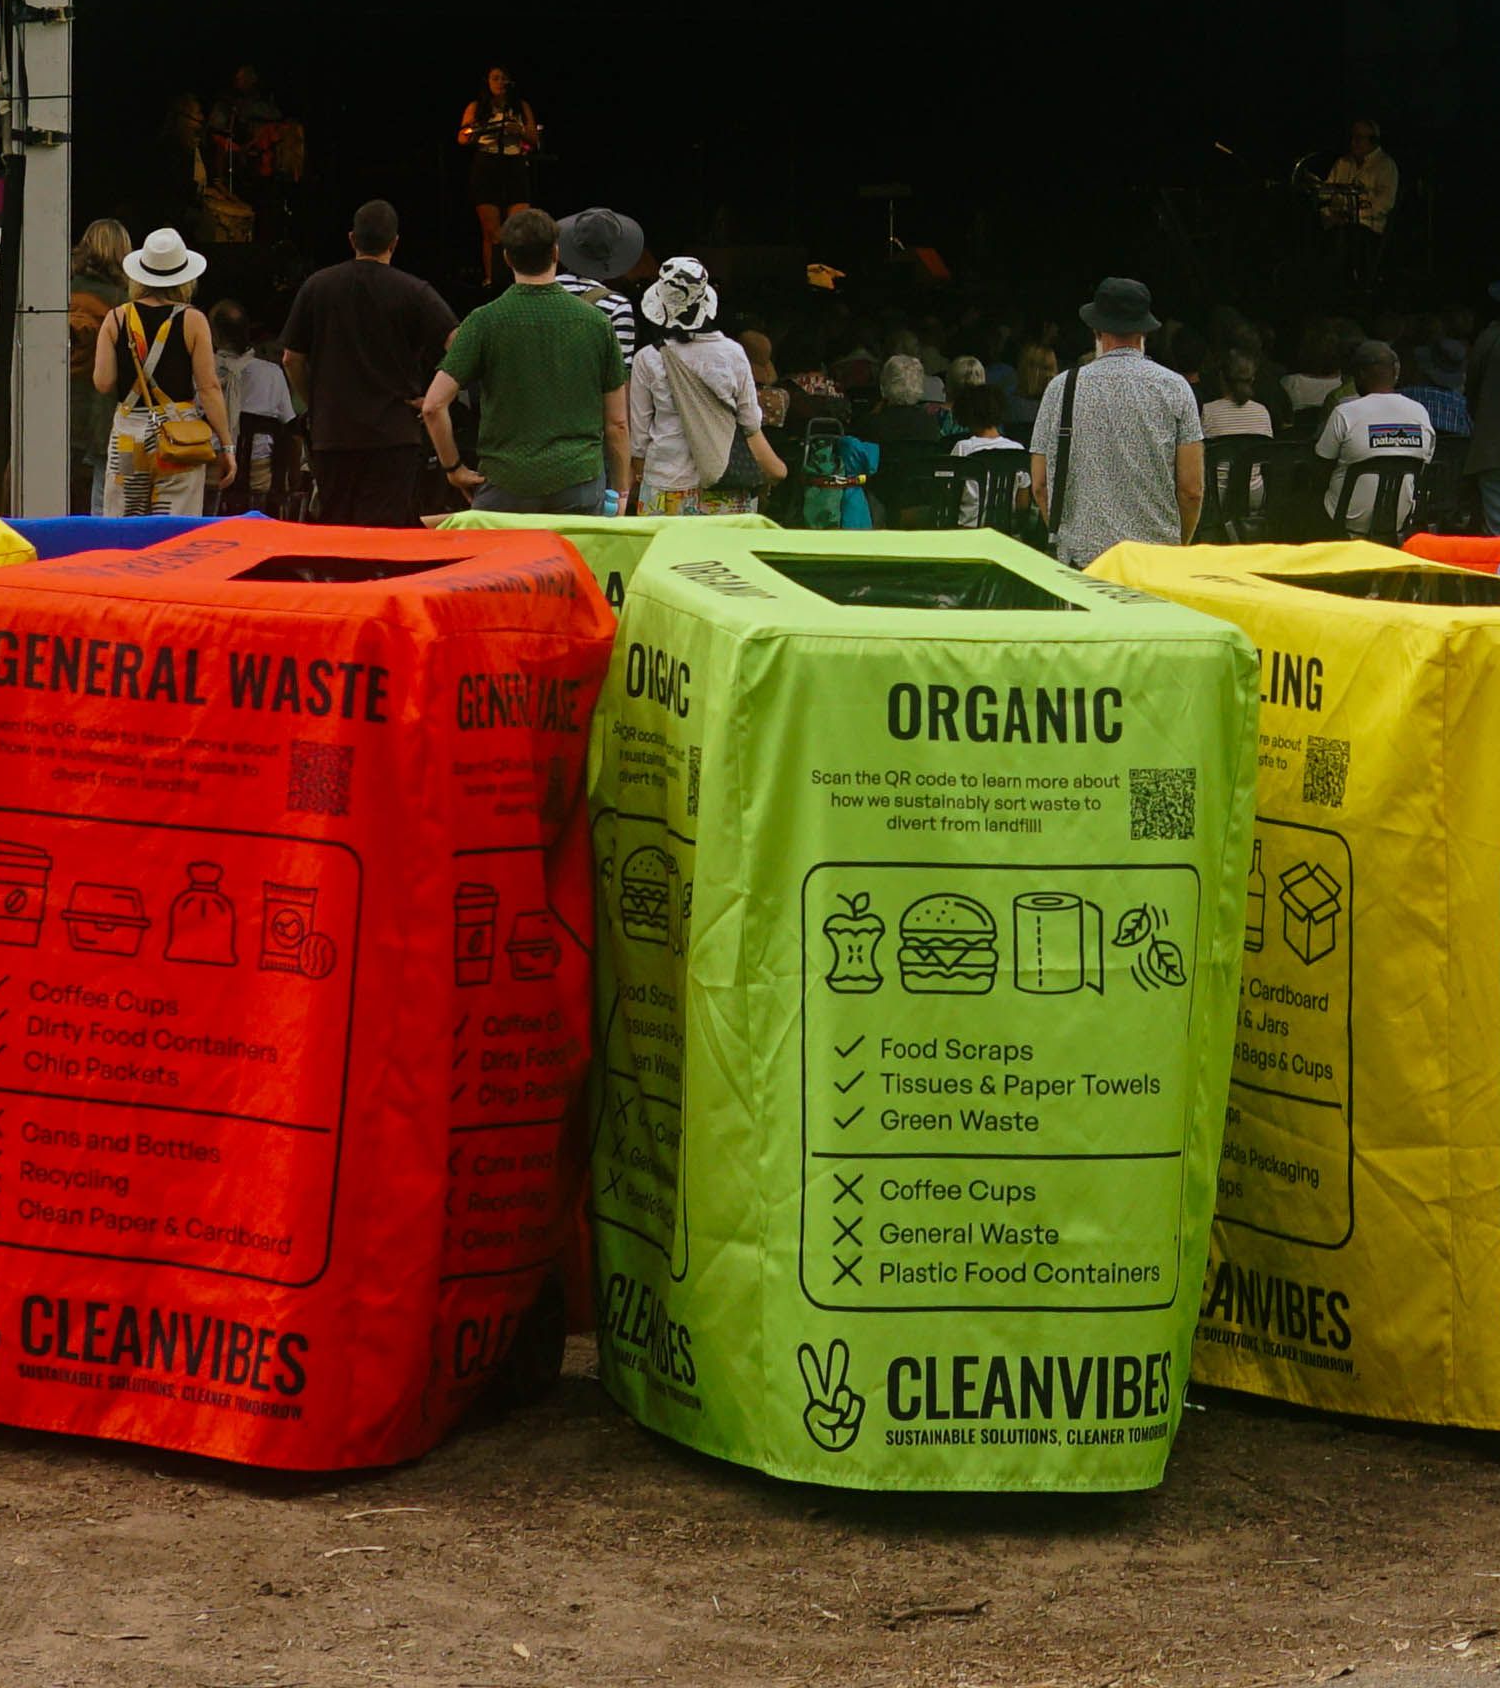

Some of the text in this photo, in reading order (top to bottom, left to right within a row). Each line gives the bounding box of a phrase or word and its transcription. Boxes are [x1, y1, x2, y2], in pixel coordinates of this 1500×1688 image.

[1372, 436, 1420, 447] patagonia
[228, 650, 390, 724] WASTE
[887, 682, 1123, 744] ORGANIC
[811, 770, 1120, 789] Scan the QR code to learn more about
[831, 793, 1101, 813] how we sustainably sort waste to
[887, 817, 937, 832] divert
[941, 817, 980, 833] from
[29, 980, 178, 1018] Coffee Cups
[1250, 977, 1329, 1013] Cardboard
[26, 1015, 278, 1064] Dirty Food Containers
[880, 1038, 1033, 1066] Food Scraps
[23, 1050, 180, 1087] Chip Packets
[880, 1072, 1160, 1101] Tissues & Paper Towels
[880, 1109, 1039, 1132] Green Waste
[21, 1121, 221, 1164] Cans and Bottles
[19, 1160, 130, 1198] Recycling
[880, 1179, 1036, 1206] Coffee Cups
[18, 1198, 293, 1256] Clean Paper & Cardboard
[880, 1223, 1059, 1245] General Waste
[880, 1262, 1160, 1284] Plastic Food Containers
[1200, 1261, 1351, 1350] ANVIBES
[20, 1294, 309, 1397] CLEANVIBES
[887, 1350, 1171, 1422] CLEANVIBES
[885, 1428, 976, 1446] SUSTAINABLE
[980, 1428, 1062, 1447] SOLUTIONS,
[1066, 1428, 1124, 1445] CLEANER
